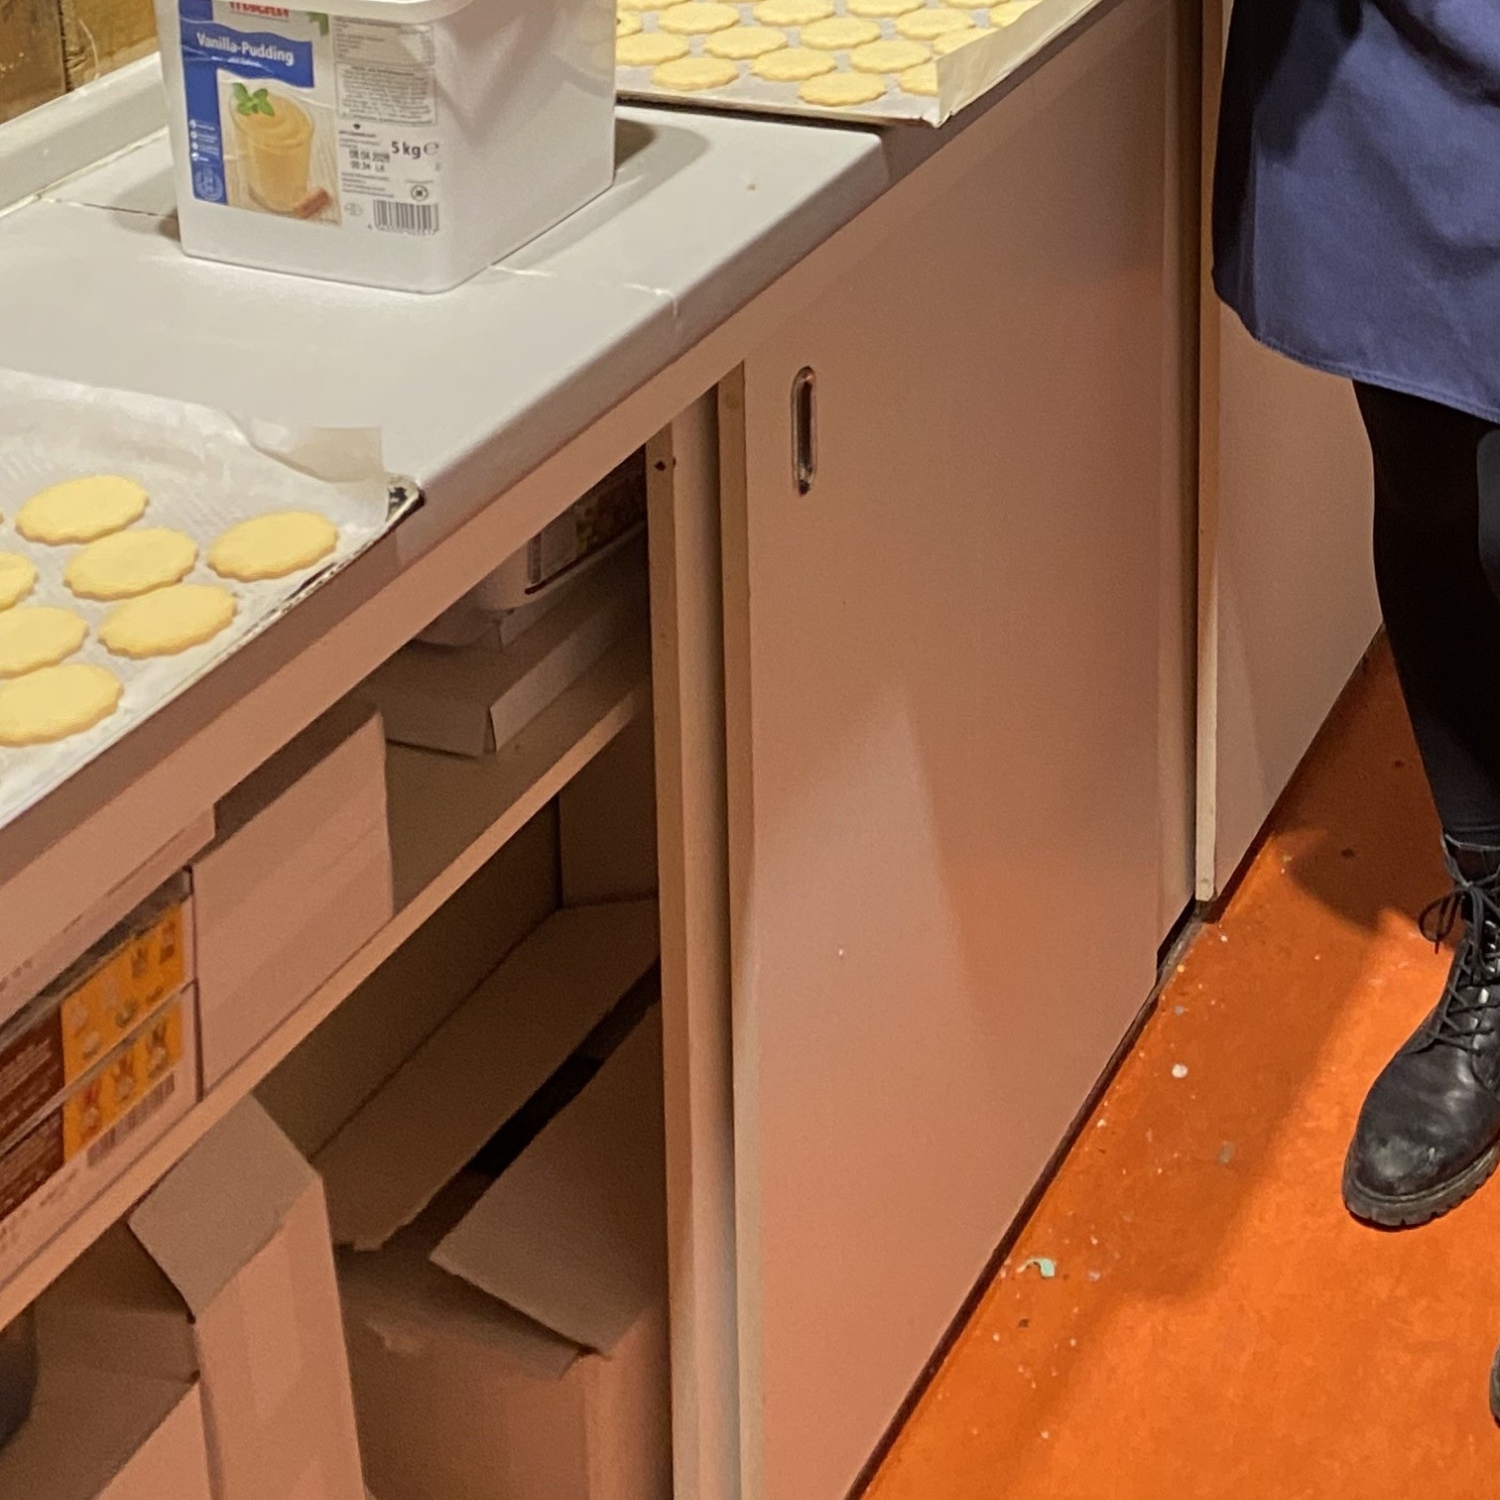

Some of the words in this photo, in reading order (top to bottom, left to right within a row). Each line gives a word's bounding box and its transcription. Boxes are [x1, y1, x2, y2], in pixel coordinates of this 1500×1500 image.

[196, 32, 295, 67] Vanilla-Pudding
[391, 141, 400, 155] 5
[402, 142, 421, 160] kg
